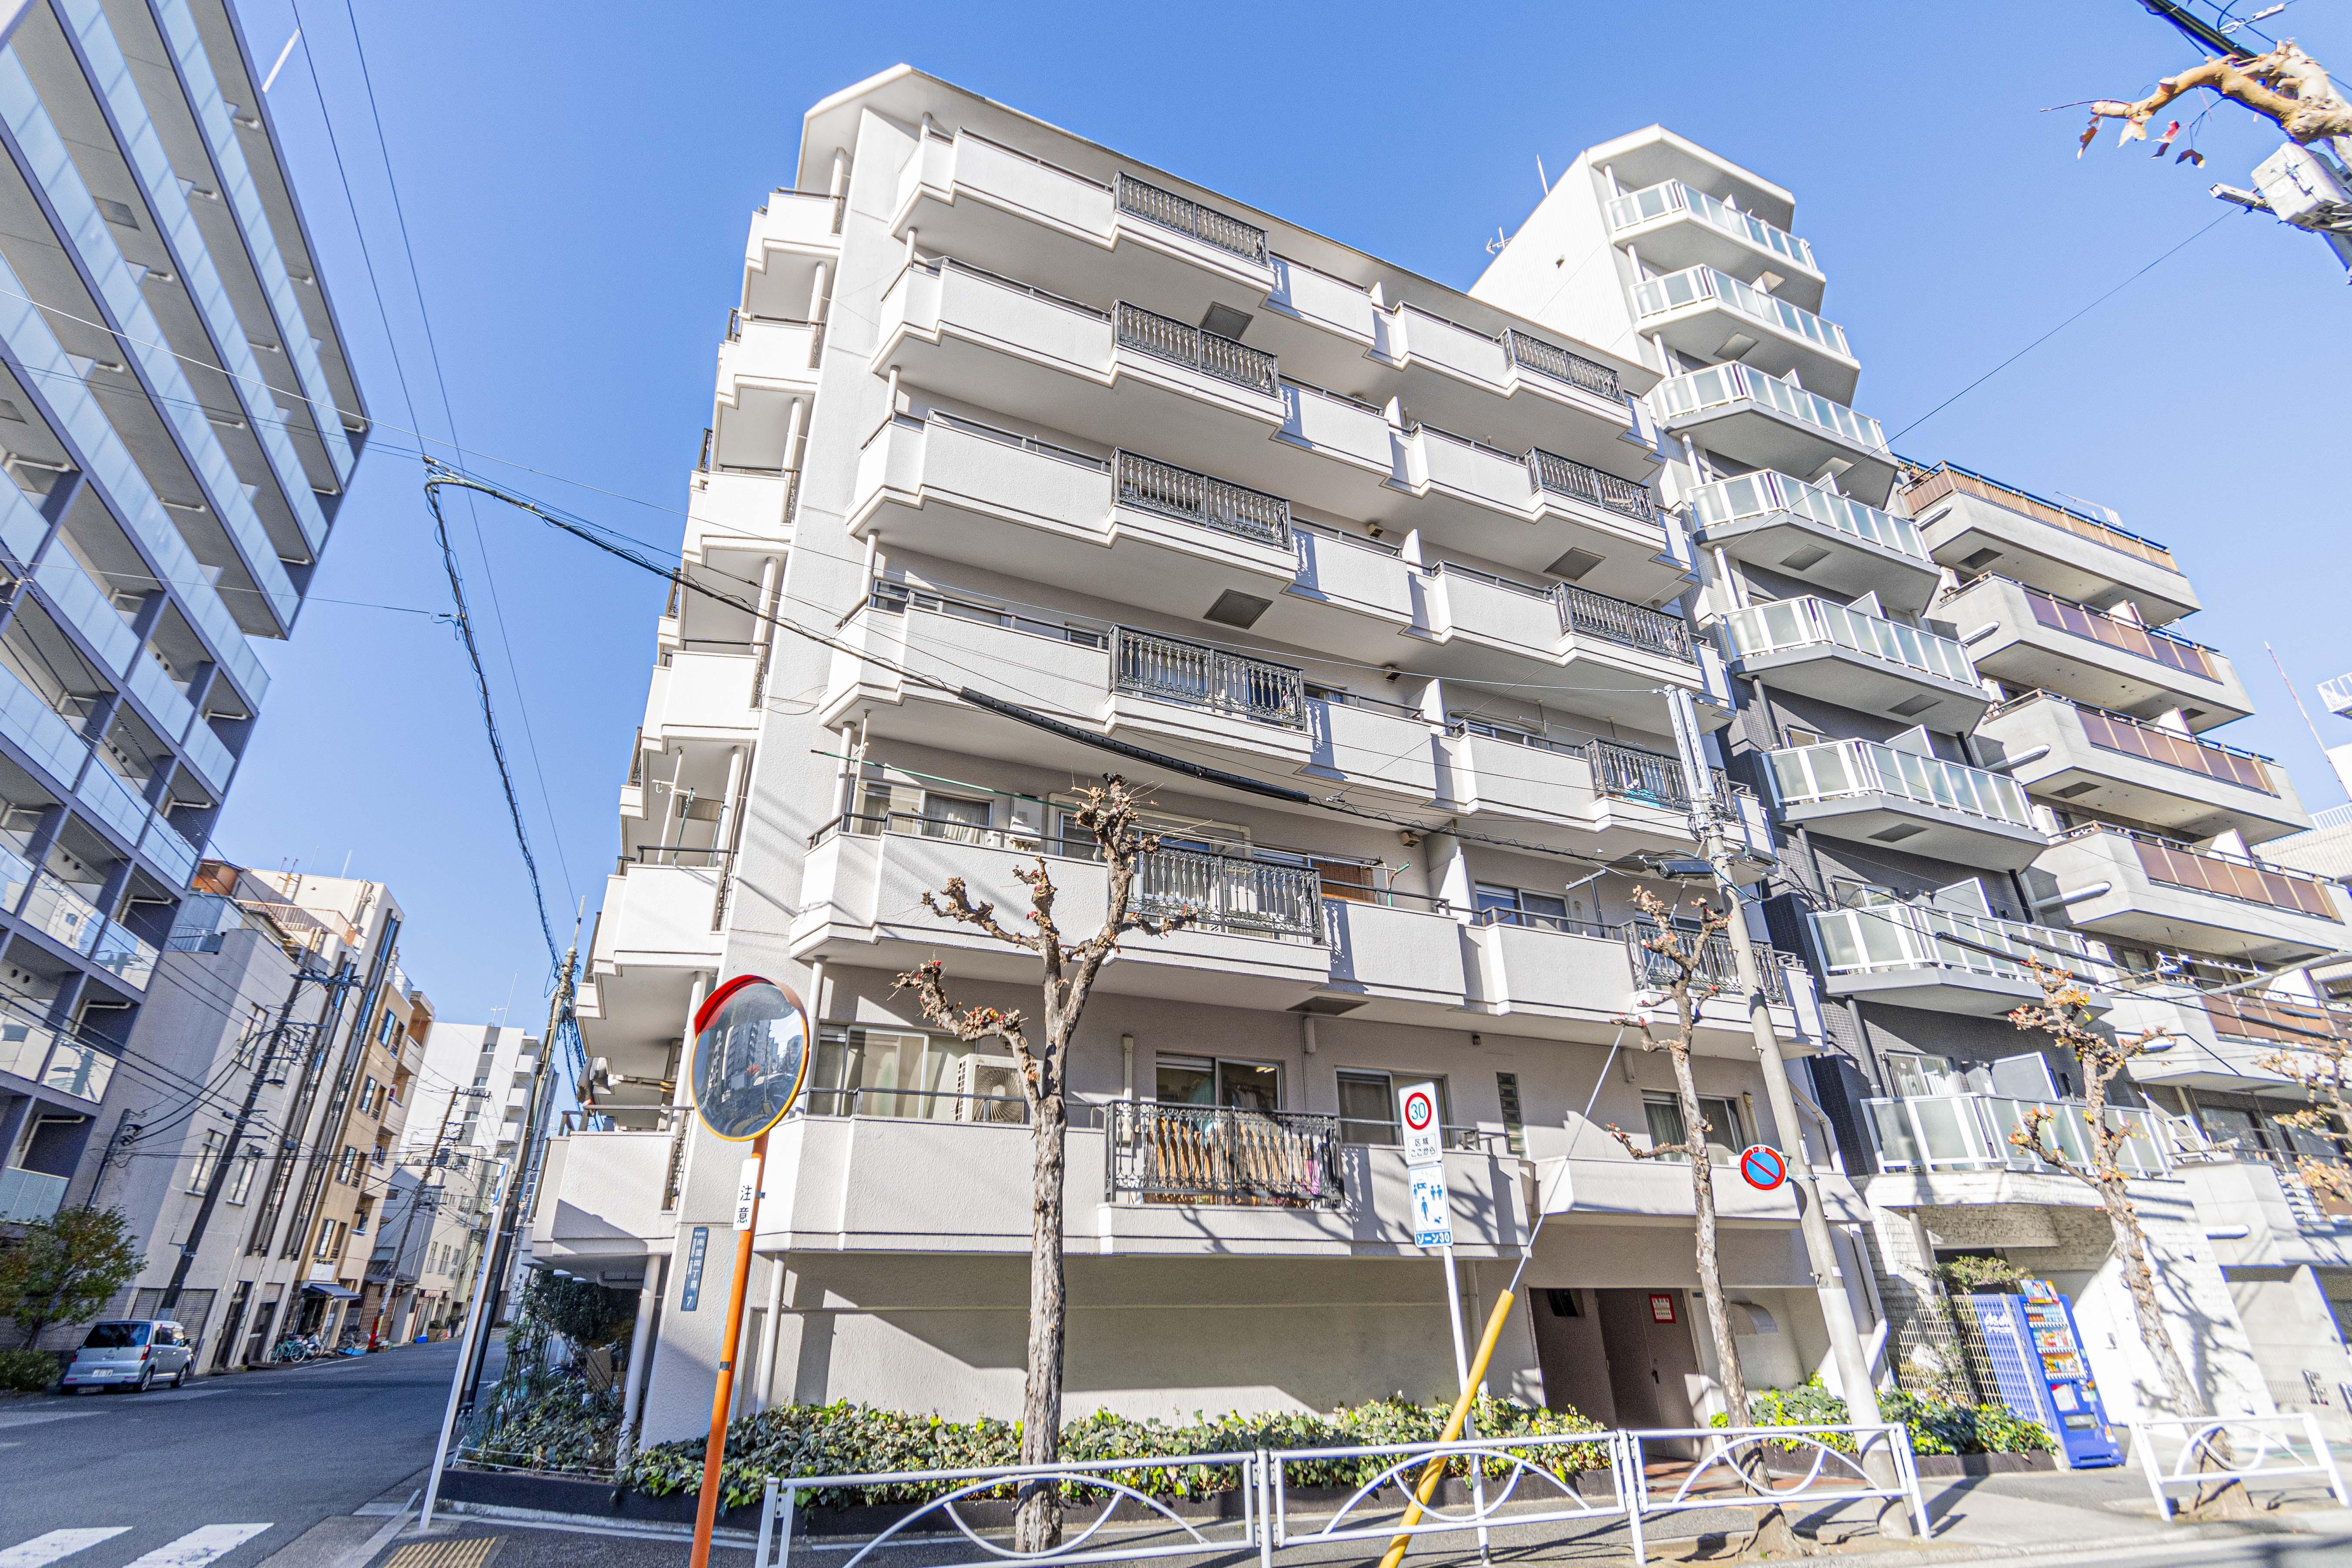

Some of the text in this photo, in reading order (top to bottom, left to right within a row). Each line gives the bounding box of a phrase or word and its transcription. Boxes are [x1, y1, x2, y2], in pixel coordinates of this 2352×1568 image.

[1411, 1102, 1426, 1120] 30
[1415, 1137, 1429, 1147] 区域
[1411, 1146, 1436, 1157] ここから
[737, 1185, 752, 1223] 注意
[687, 1239, 704, 1307] 両国四丁目 7
